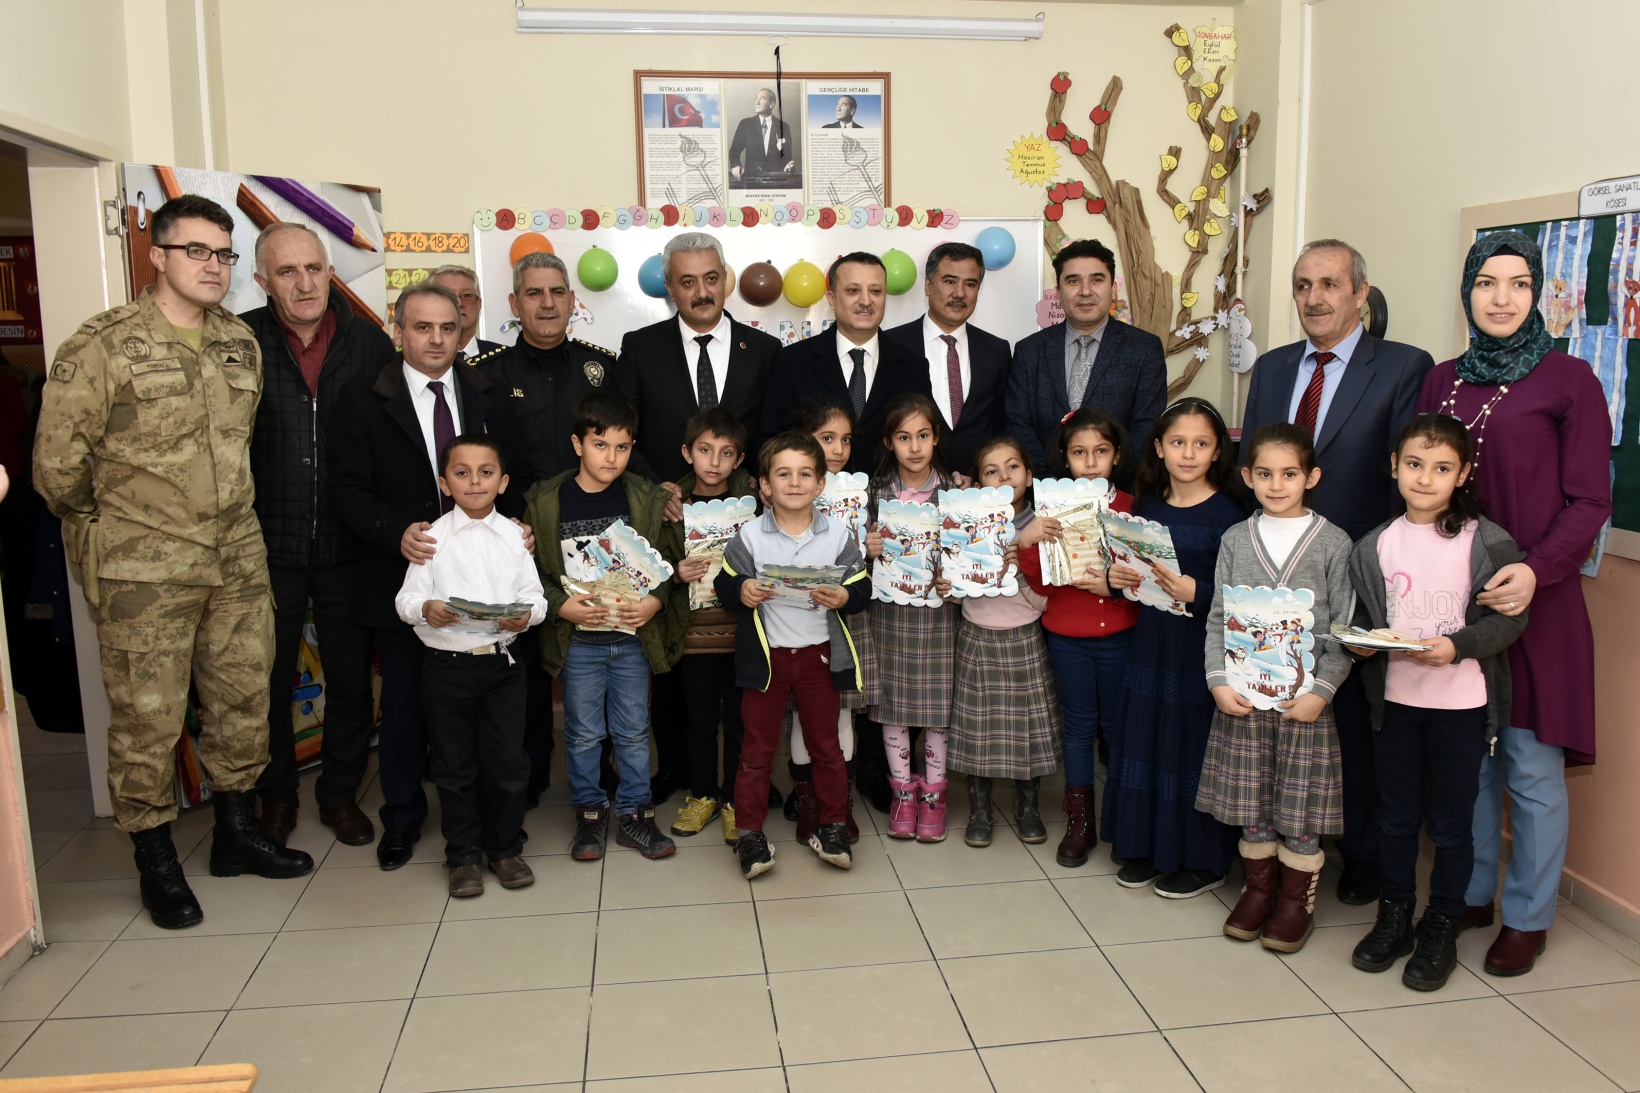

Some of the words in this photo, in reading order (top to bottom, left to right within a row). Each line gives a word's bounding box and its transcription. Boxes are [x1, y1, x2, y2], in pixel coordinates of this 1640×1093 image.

[1197, 31, 1232, 41] SONBAHAR
[1203, 39, 1221, 50] Eylül
[658, 85, 684, 93] İSTİKLAL
[819, 86, 847, 94] GENÇLİĞE
[1024, 143, 1043, 152] YAZ
[1017, 153, 1044, 161] Haziran
[1019, 168, 1045, 178] Ağustos
[1587, 185, 1611, 197] GÖRSEL
[1614, 181, 1640, 193] SANATL
[1605, 196, 1627, 209] KÖŞESİ
[500, 214, 510, 225] A
[517, 213, 526, 225] B
[533, 215, 543, 226] C
[549, 213, 560, 225] Ç
[568, 215, 576, 224] D
[584, 215, 593, 225] E
[602, 212, 611, 221] F
[617, 214, 627, 225] G
[633, 208, 643, 221] Ğ
[649, 214, 659, 223] H
[696, 212, 703, 222] J
[713, 213, 721, 221] K
[729, 211, 737, 221] L
[744, 212, 755, 221] M
[760, 208, 768, 218] N
[775, 211, 784, 221] O
[790, 206, 799, 218] Ö
[807, 210, 814, 220] P
[822, 213, 830, 223] R
[838, 209, 846, 220] S
[854, 212, 862, 224] Ş
[870, 208, 879, 219] T
[885, 214, 894, 223] U
[900, 207, 908, 220] Ü
[914, 214, 924, 224] V
[929, 210, 937, 223] Y
[944, 214, 954, 225] Z
[391, 236, 405, 248] 14
[411, 235, 424, 249] 16
[431, 235, 445, 249] 18
[451, 236, 467, 249] 20
[0, 248, 12, 256] EK
[394, 273, 407, 285] 21
[1044, 292, 1059, 300] İLKB
[1051, 302, 1062, 310] Ma
[1048, 311, 1064, 319] Nisa
[972, 560, 982, 570] İYİ
[902, 571, 912, 580] İYİ
[1259, 670, 1271, 680] İYİ
